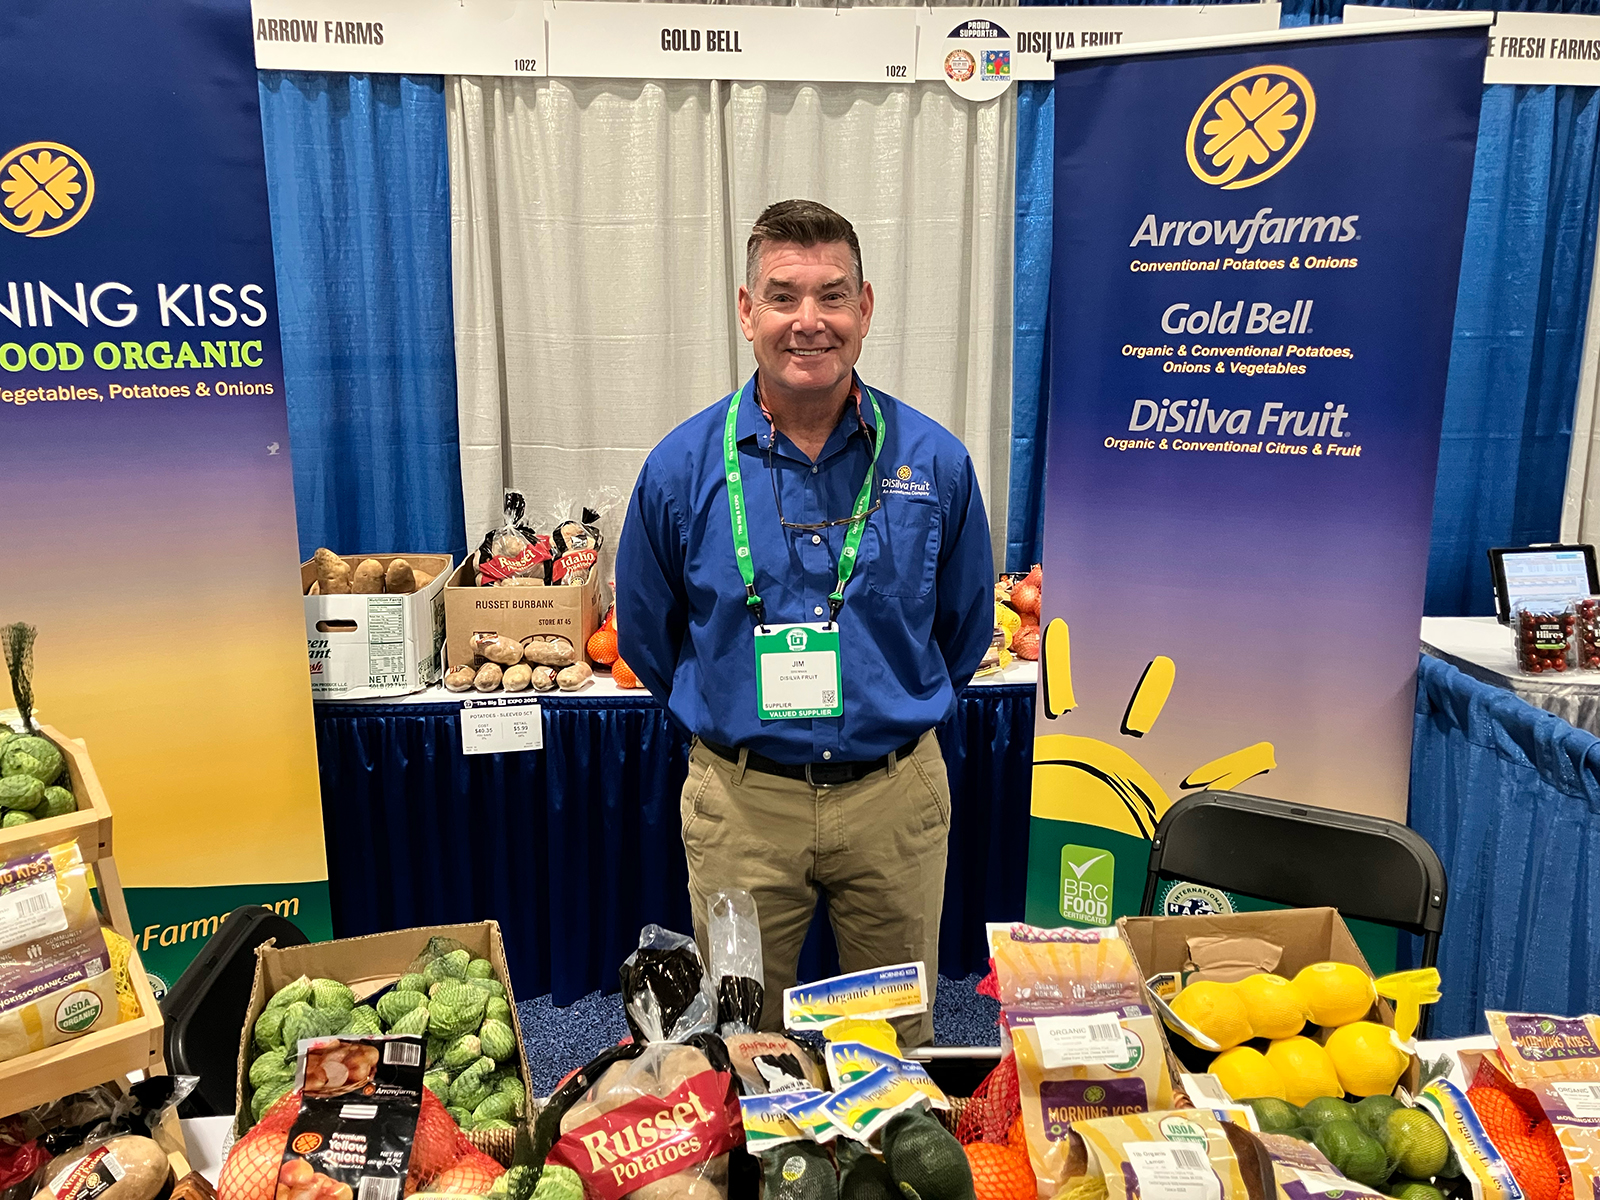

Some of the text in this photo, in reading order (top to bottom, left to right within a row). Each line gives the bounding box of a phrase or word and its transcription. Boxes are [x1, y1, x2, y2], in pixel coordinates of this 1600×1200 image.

[256, 18, 384, 46] ARROW FARMS
[959, 29, 998, 38] SUPPORTER
[967, 21, 990, 30] PROUD
[661, 28, 743, 53] GOLD BELL
[1500, 36, 1546, 59] FRESH
[1550, 38, 1600, 61] FARMS
[513, 58, 537, 72] 1022
[885, 64, 907, 78] 1022
[1129, 207, 1359, 254] Arrowfarms
[1129, 255, 1358, 273] Conventional Potatoes & Onions
[157, 283, 268, 328] KISS
[1161, 300, 1313, 335] Gold Bell
[93, 340, 264, 371] ORGANIC
[1121, 344, 1354, 360] Organic & Conventional Potatoes,
[1162, 361, 1307, 377] Onions & Vegetables
[0, 381, 274, 406] egetables, Potatoes & Onions
[1128, 398, 1349, 438] DiSilva Fruit
[1104, 437, 1362, 457] Organic & Conventional Citrus & Fruit
[881, 478, 930, 491] DiSilva Fruit
[497, 549, 537, 569] Russet
[560, 550, 595, 569] Idaho
[475, 599, 554, 610] RUSSET BURBANK
[538, 618, 556, 626] STORE
[556, 618, 564, 626] AT
[791, 660, 805, 668] JIM
[369, 674, 388, 684] NET
[769, 709, 832, 718] VALUED SUPPLIER
[1064, 878, 1109, 902] BRC
[1173, 887, 1224, 911] INTERNATIONAL
[1063, 895, 1108, 918] FOOD
[1063, 910, 1108, 925] CERTIFICATED
[879, 968, 905, 979] MORNING
[827, 987, 869, 1006] Organic
[872, 981, 915, 997] Lemons
[64, 998, 91, 1017] USDA
[62, 1008, 96, 1028] ORGANIC
[1049, 1027, 1087, 1037] ORGANIC
[1522, 1047, 1597, 1059] OGANIC
[761, 1110, 790, 1124] Orga
[1048, 1105, 1109, 1123] MORNING
[331, 1132, 367, 1142] Premium
[579, 1090, 712, 1174] Russet
[1167, 1124, 1196, 1135] USDA
[328, 1139, 368, 1154] Yellow
[1453, 1110, 1504, 1191] Organic Lies
[323, 1149, 367, 1165] Onions
[610, 1135, 702, 1188] Potatoes
[62, 1156, 93, 1190] Wrapped
[64, 1172, 87, 1200] Russet
[83, 1151, 106, 1175] Potato
